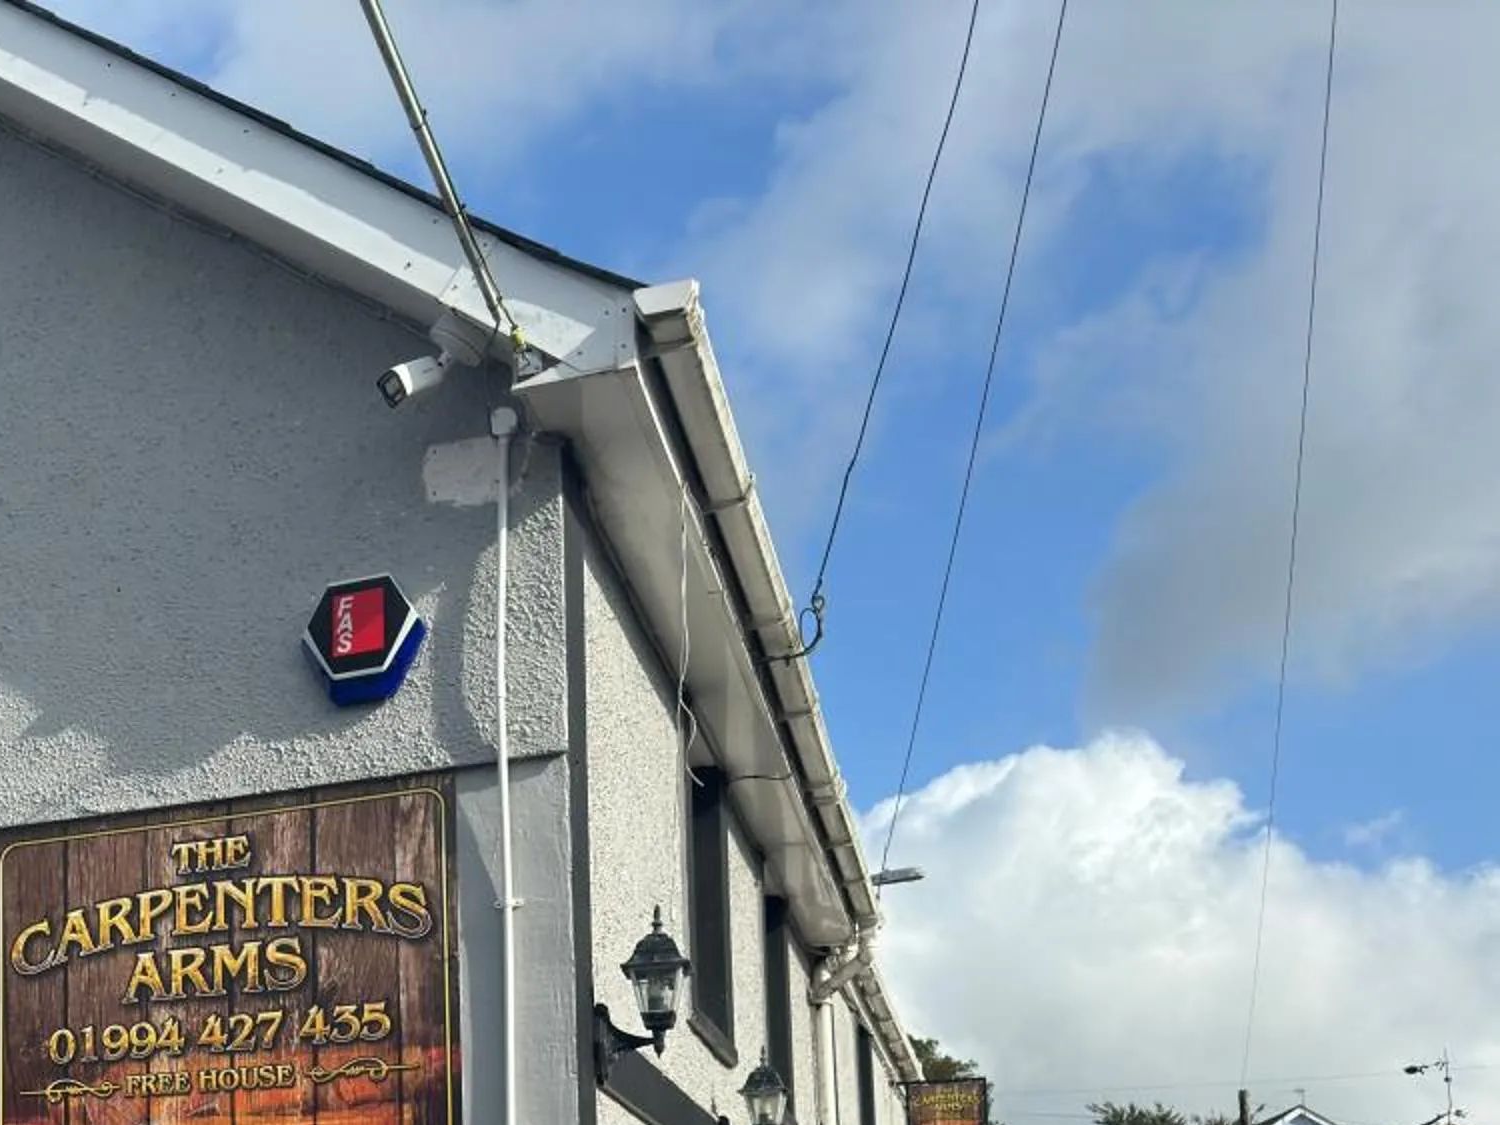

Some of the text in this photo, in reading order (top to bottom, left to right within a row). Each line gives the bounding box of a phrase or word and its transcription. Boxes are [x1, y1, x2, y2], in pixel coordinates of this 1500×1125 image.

[336, 596, 354, 654] FAS
[171, 833, 252, 876] THE
[10, 873, 434, 976] CARPENTERS
[121, 937, 309, 1005] ARMS
[47, 1001, 392, 1066] 01994 427 435
[125, 1064, 297, 1097] FREE HOUSE
